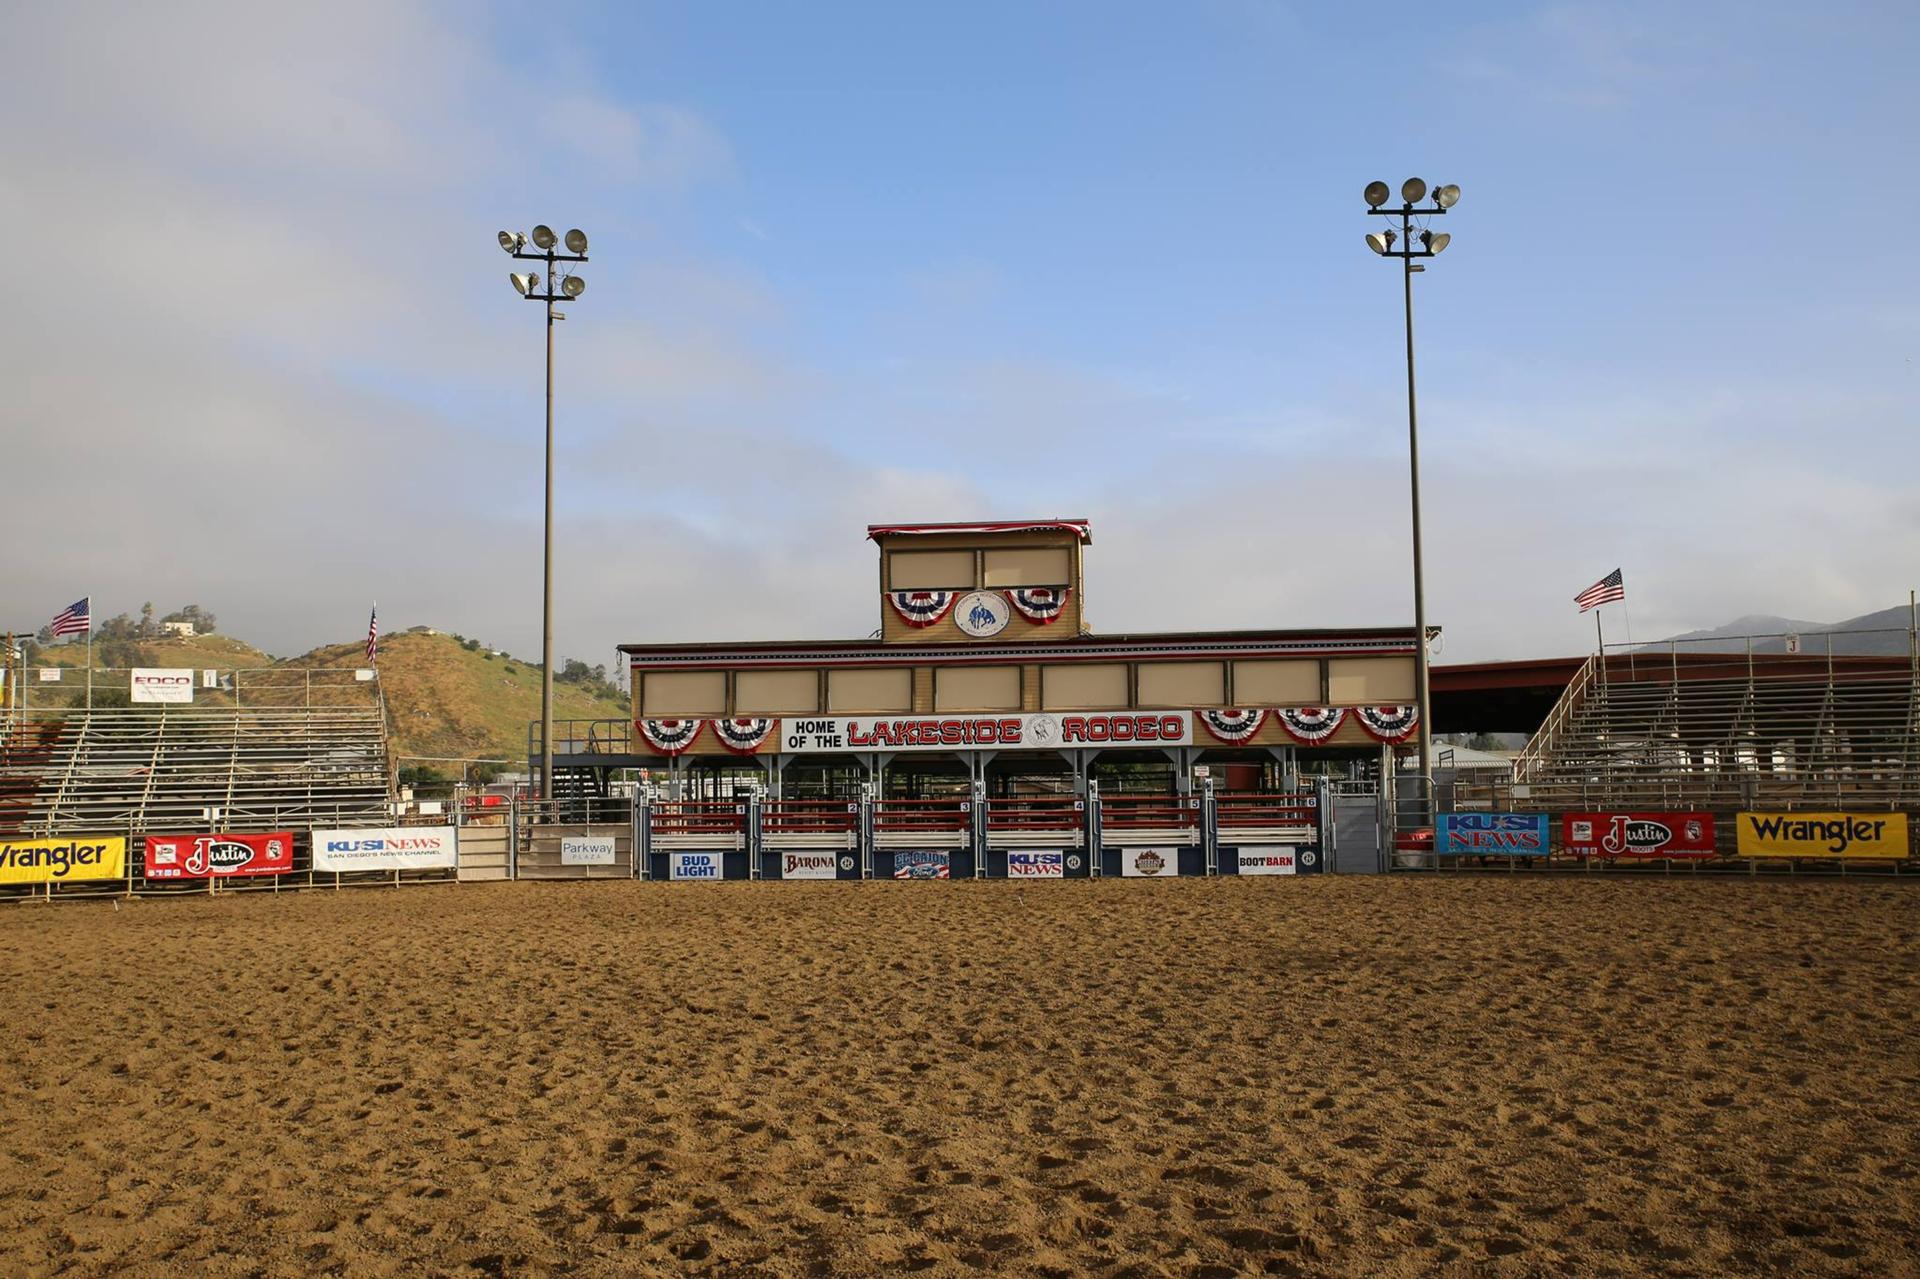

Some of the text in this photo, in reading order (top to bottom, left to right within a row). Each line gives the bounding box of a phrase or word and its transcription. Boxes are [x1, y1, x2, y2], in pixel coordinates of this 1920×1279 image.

[796, 721, 836, 734] HOME
[847, 718, 1023, 747] LAKESIDE
[1062, 715, 1185, 743] RODEO
[788, 735, 842, 748] OF THE
[1448, 816, 1539, 830] KUSI
[1448, 832, 1541, 848] NEWS
[1602, 816, 1665, 854] Justin
[1750, 816, 1886, 853] Wrangler
[327, 838, 440, 852] KUSI NEWS
[564, 843, 612, 854] Parkway
[185, 838, 248, 874] Justin
[682, 856, 710, 866] BUD
[1009, 854, 1062, 864] KUSI
[676, 866, 716, 876] LIGHT
[784, 854, 835, 874] BARONA
[1010, 864, 1062, 875] NEWS
